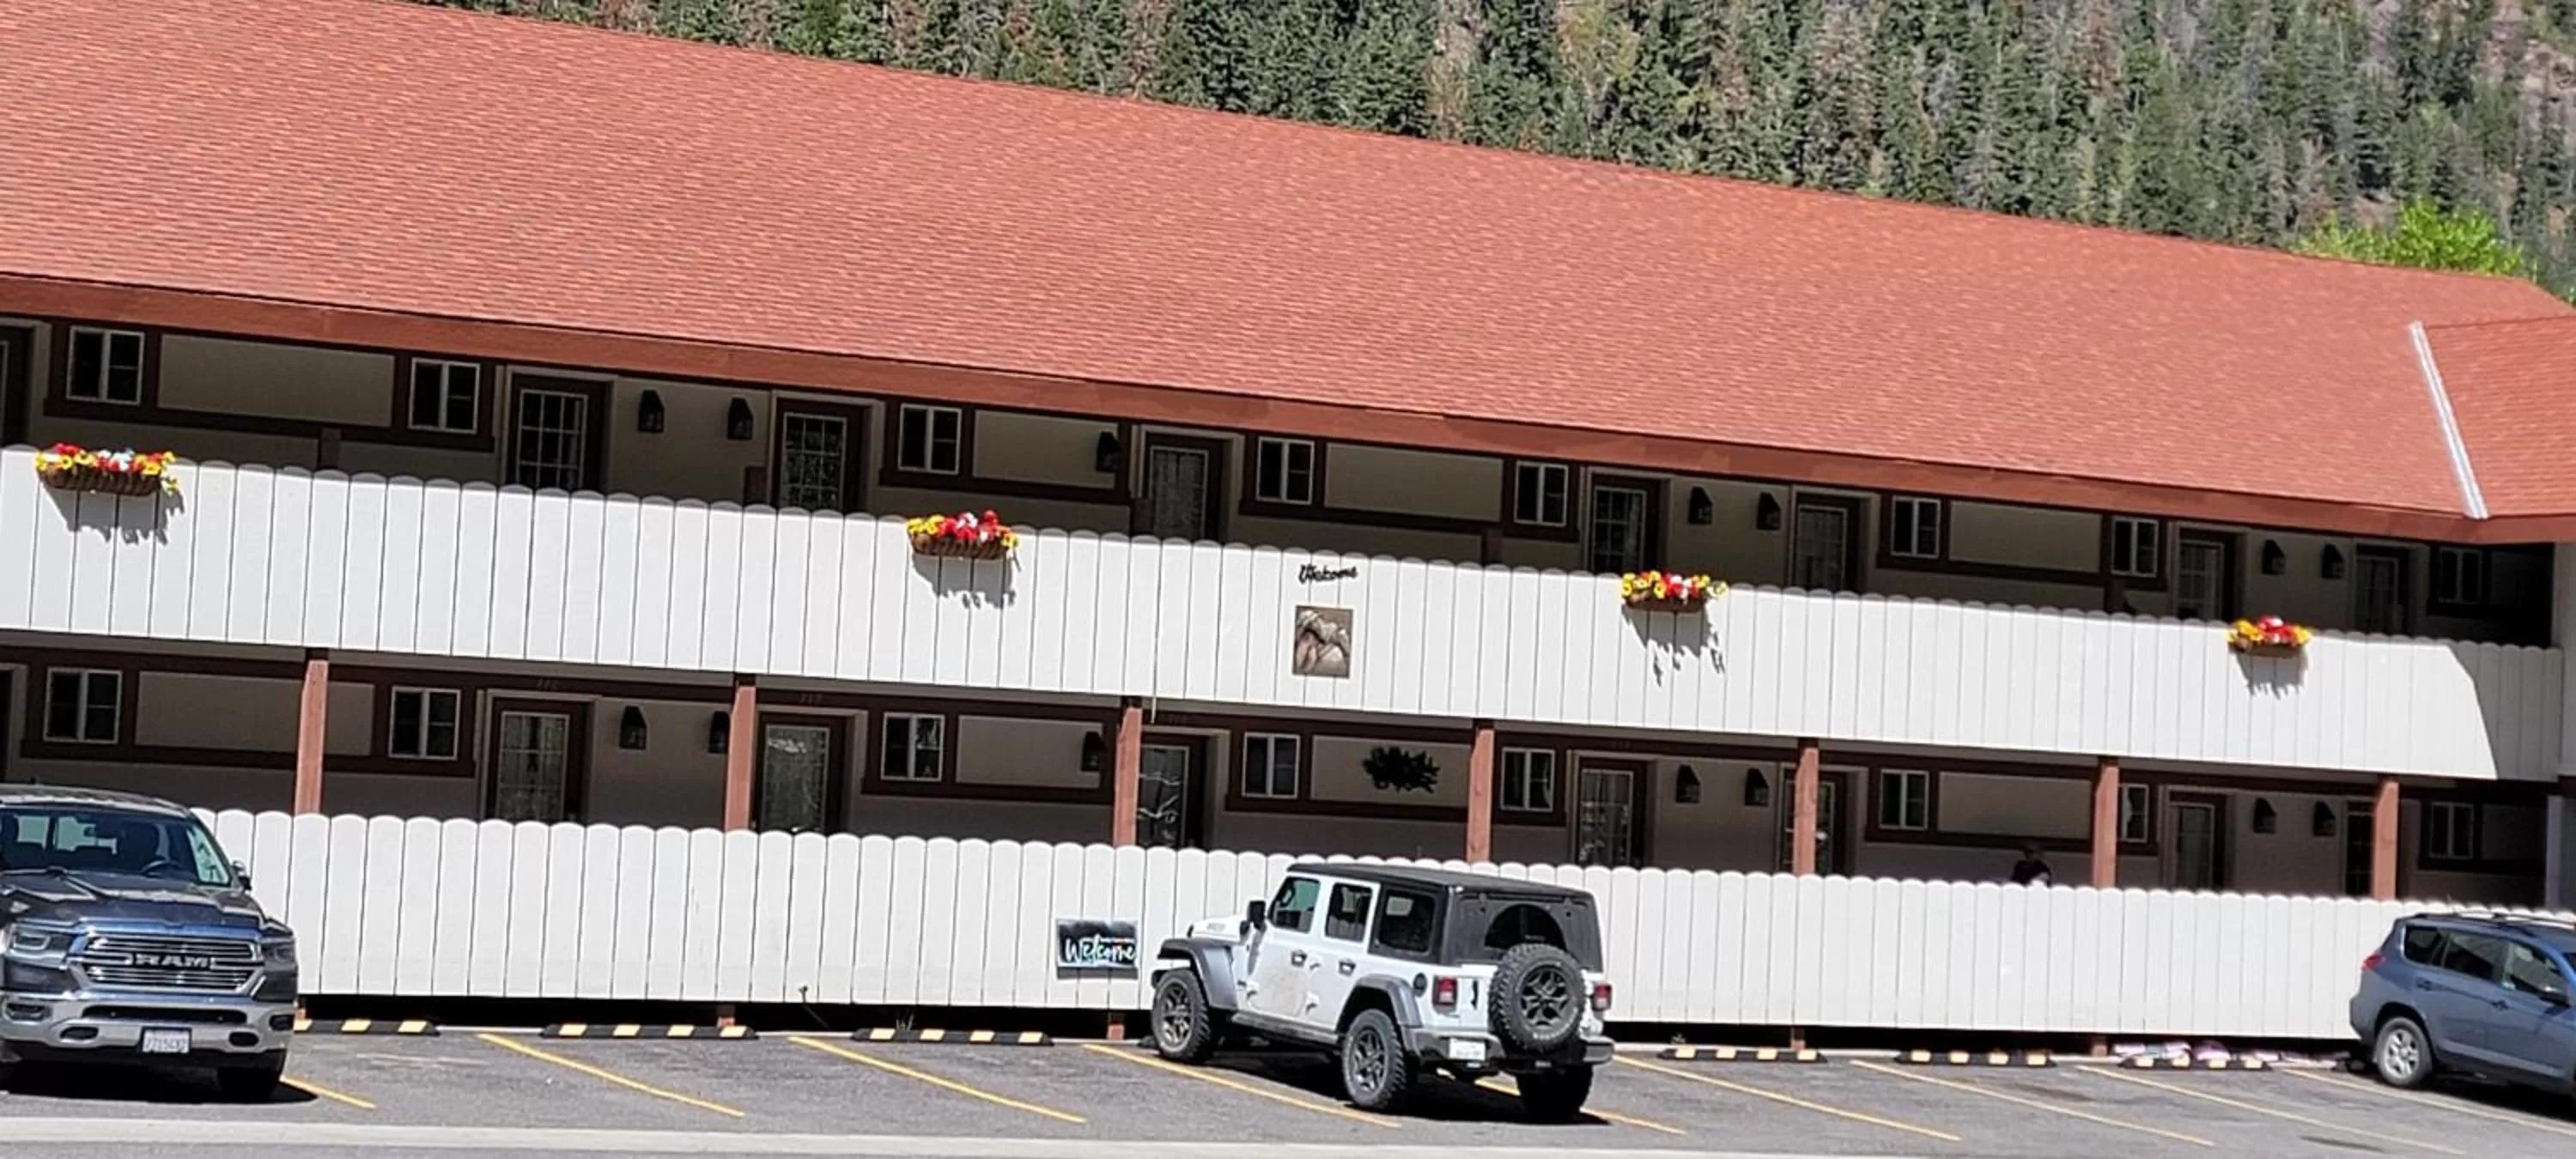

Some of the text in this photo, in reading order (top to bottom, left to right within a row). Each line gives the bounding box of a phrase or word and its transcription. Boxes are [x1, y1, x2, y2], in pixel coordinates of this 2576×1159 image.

[1298, 564, 1358, 584] Welcome
[1065, 933, 1136, 964] Welcome
[136, 953, 208, 968] RAM
